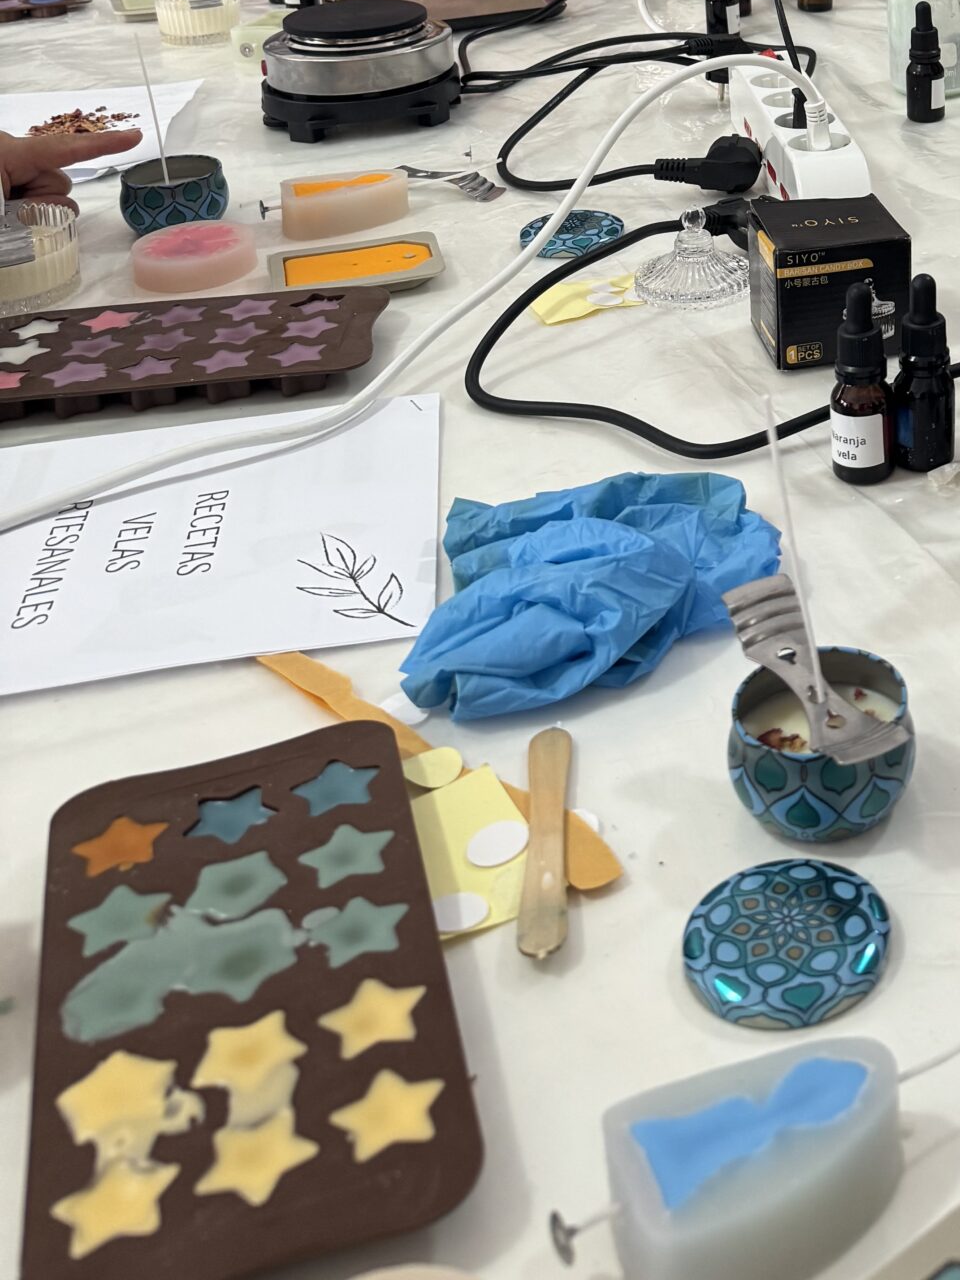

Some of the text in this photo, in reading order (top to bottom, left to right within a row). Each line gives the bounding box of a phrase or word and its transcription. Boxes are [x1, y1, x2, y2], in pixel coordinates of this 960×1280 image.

[819, 263, 845, 273] CANDY
[798, 349, 821, 361] PCS
[836, 449, 857, 461] vela
[105, 511, 157, 573] VELAS
[177, 489, 230, 576] RECETAS
[11, 498, 94, 629] RTESANALES
